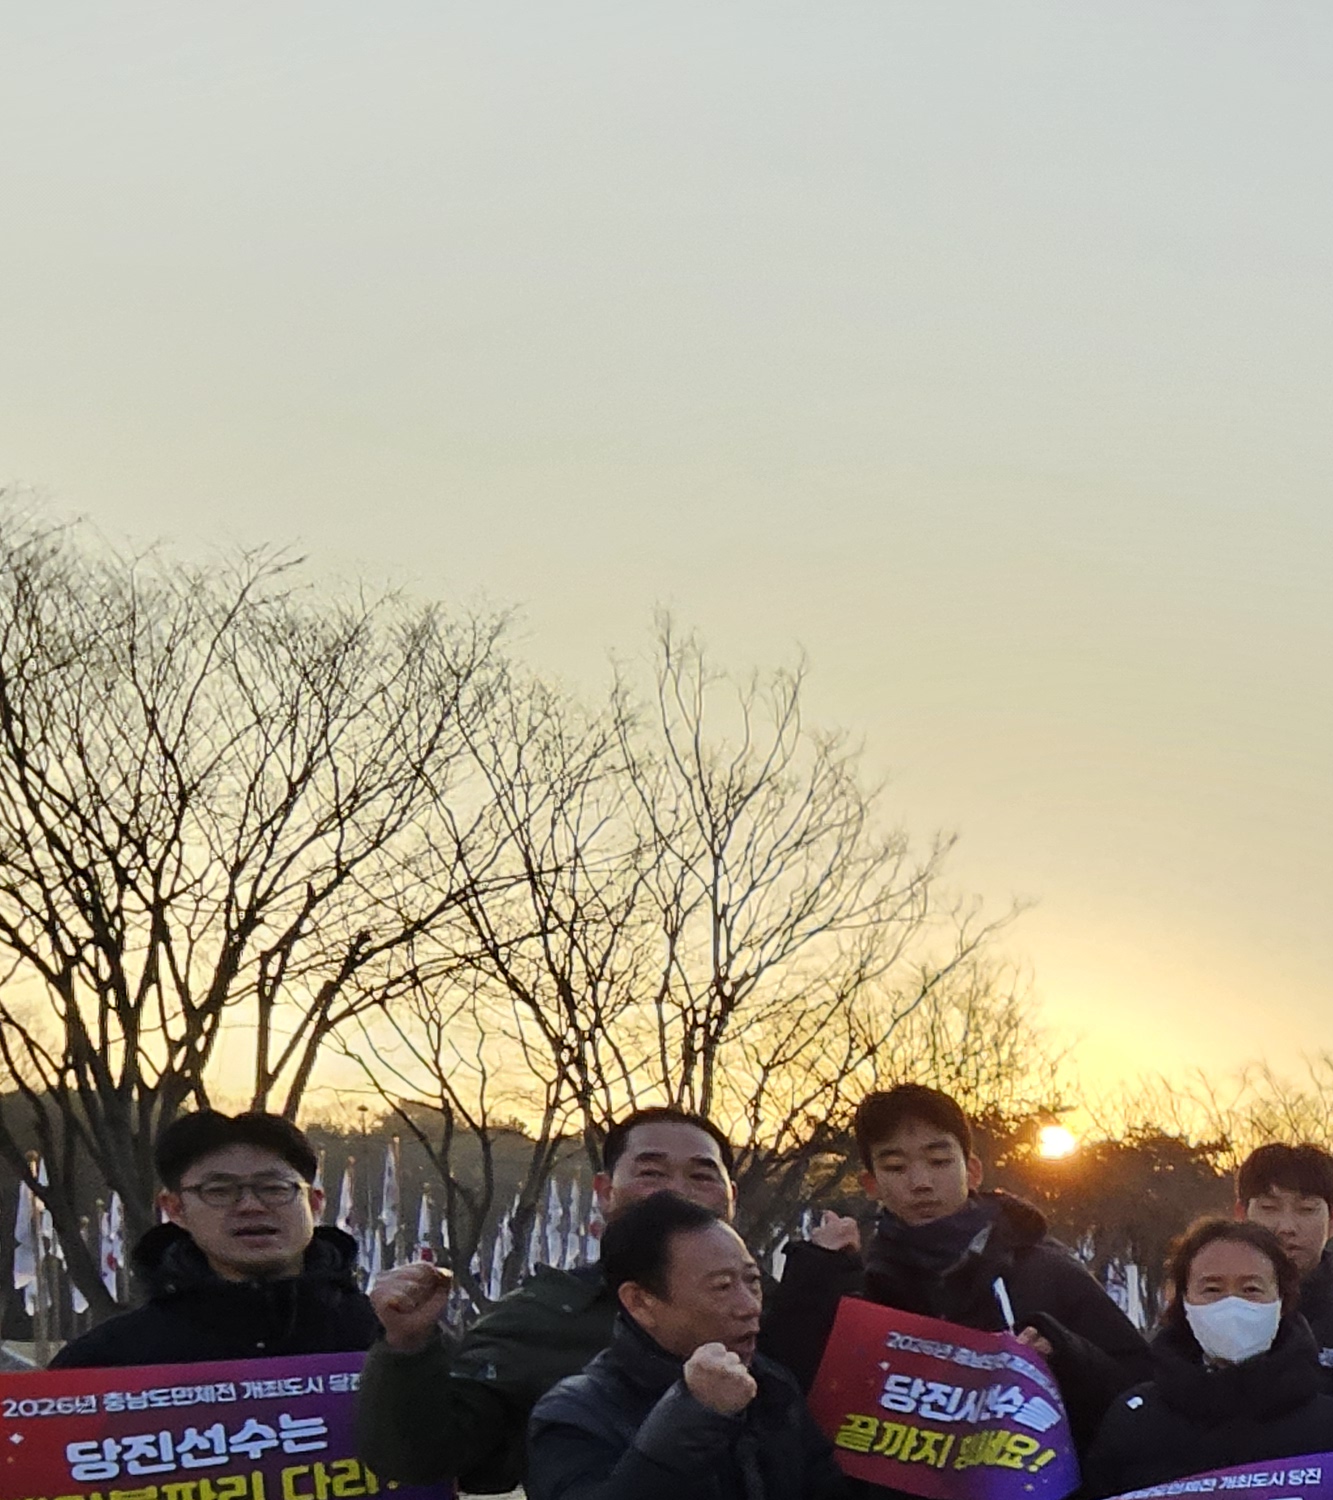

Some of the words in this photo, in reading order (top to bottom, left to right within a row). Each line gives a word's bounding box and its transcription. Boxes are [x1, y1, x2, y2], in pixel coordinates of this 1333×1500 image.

[2, 1393, 97, 1417] 2026년
[67, 1413, 328, 1481] 당진선수는
[834, 1413, 955, 1468] 끝까지
[1288, 1467, 1322, 1486] 당진
